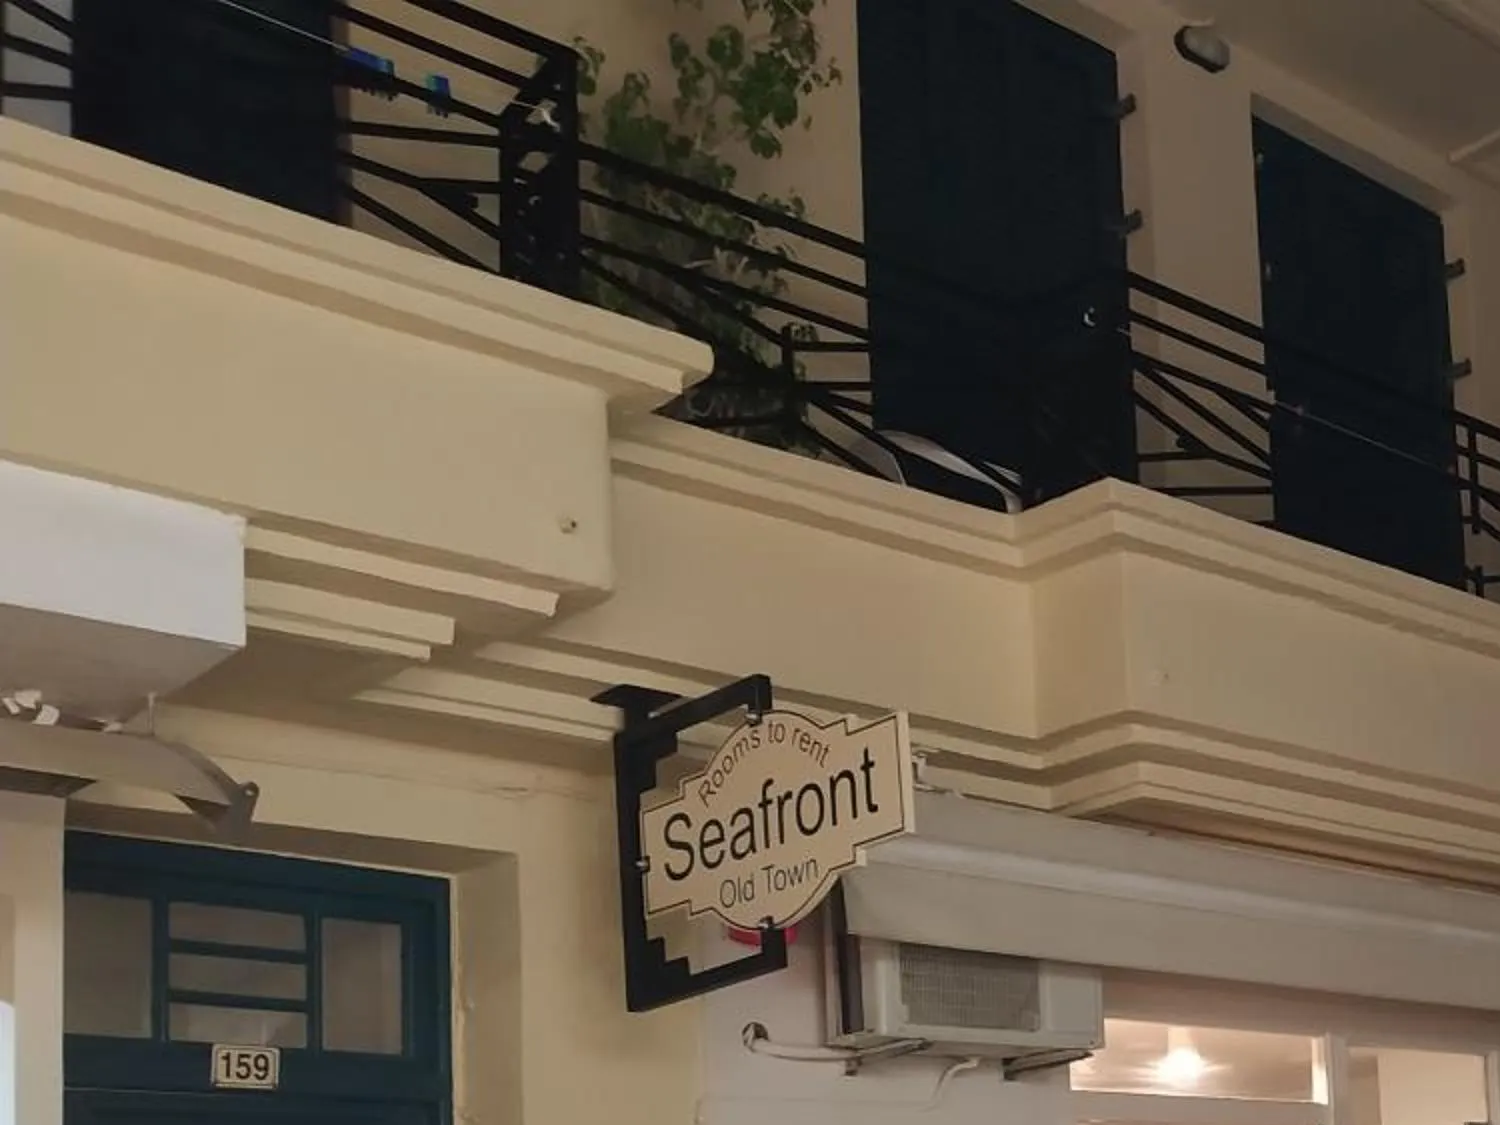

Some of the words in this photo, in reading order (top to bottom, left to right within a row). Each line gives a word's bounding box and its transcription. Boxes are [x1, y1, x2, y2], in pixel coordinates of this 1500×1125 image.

[698, 729, 761, 807] Rooms
[767, 721, 786, 744] to
[791, 727, 831, 768] rent
[664, 747, 878, 881] Seafront
[719, 878, 755, 908] Old
[762, 858, 819, 893] Town
[220, 1051, 269, 1081] 159
